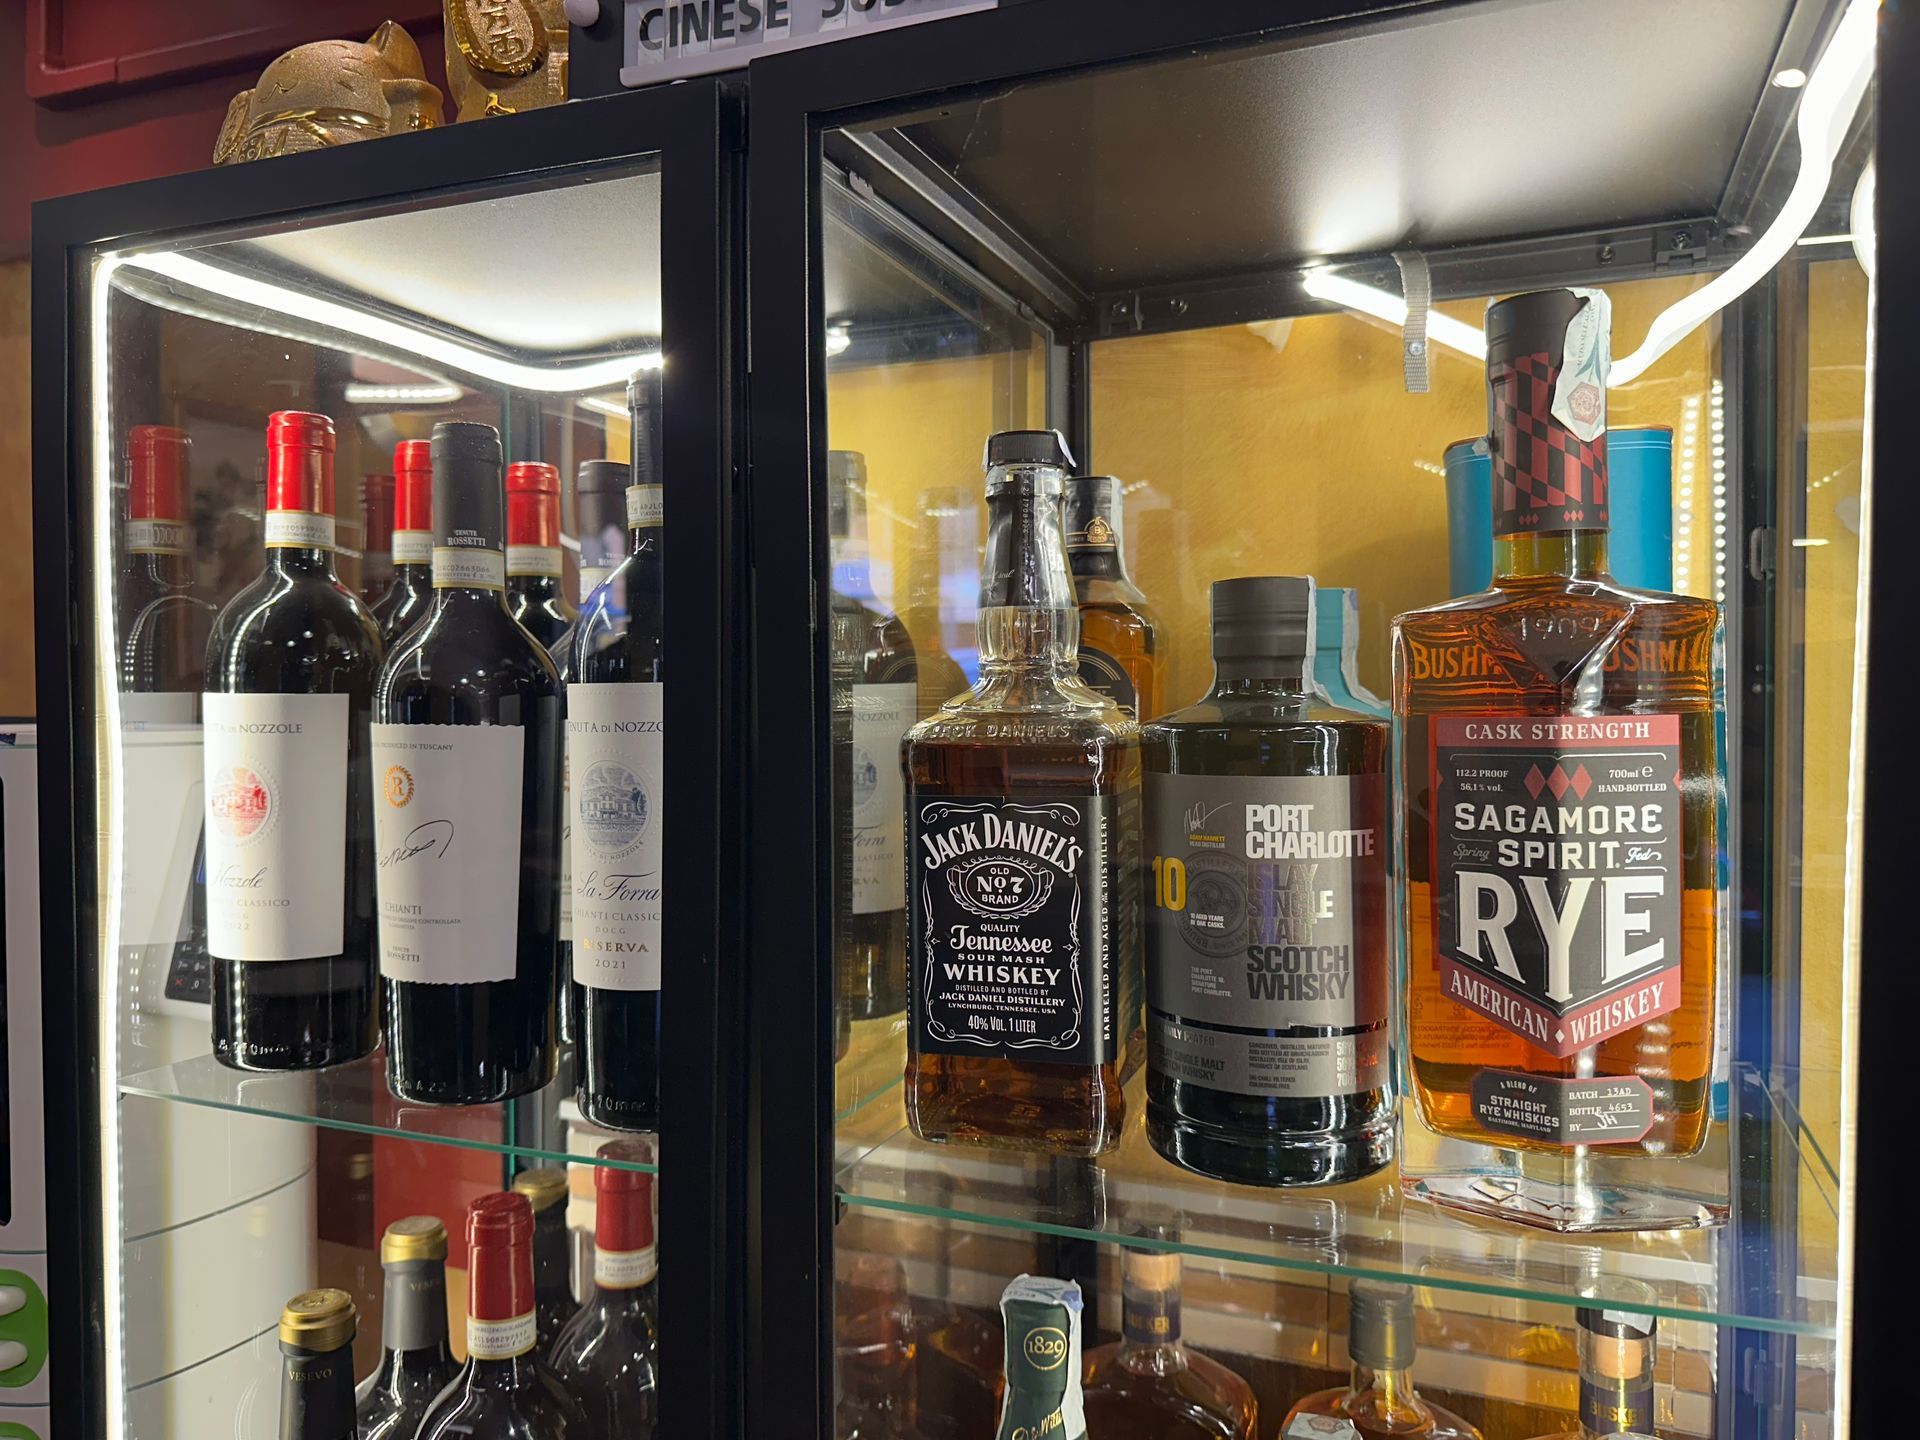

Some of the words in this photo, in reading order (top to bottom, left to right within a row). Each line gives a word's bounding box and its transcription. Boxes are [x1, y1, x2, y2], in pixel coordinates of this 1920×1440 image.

[639, 0, 788, 51] CINESE
[454, 529, 478, 537] TENUTE
[448, 537, 486, 547] ROSSETTI
[239, 723, 303, 734] NOZZOLE
[601, 725, 611, 733] DI
[1465, 723, 1524, 740] CASK
[1532, 721, 1651, 741] STRENGTH
[419, 743, 454, 751] TUSCANY
[1455, 769, 1477, 778] 112.2
[1479, 769, 1509, 778] PROOF
[1608, 768, 1639, 780] 700ml
[391, 776, 404, 796] R
[1486, 784, 1504, 793] vol.
[1597, 783, 1667, 793] HAND-BOTTLED
[1245, 803, 1314, 832] PORT
[1454, 802, 1663, 835] SAGAMORE
[920, 819, 983, 871] JACK
[982, 812, 1084, 874] DANIEL'S
[1245, 829, 1375, 860] CHARLOTTE
[1453, 843, 1490, 861] Spring
[1497, 838, 1620, 870] SPIRIT
[1624, 846, 1662, 864] Fed
[990, 866, 1010, 876] OLD
[1246, 863, 1319, 892] ISLAY
[1151, 854, 1188, 912] 10
[236, 898, 291, 908] CLASSICO
[981, 894, 1019, 905] BRAND
[1246, 889, 1335, 919] SINGLE
[384, 901, 422, 915] CHIANTI
[1207, 914, 1224, 922] YEARS
[1207, 921, 1225, 929] CASKS.
[595, 927, 626, 935] DOCG
[980, 923, 1020, 933] QUALITY
[1246, 916, 1318, 945] MALT
[950, 924, 1053, 953] Tennessee
[1455, 870, 1665, 1003] RYE
[583, 938, 649, 953] RISERVA
[386, 950, 420, 963] ROSSETTI
[595, 959, 626, 969] 2021
[957, 953, 996, 962] SOUR
[1002, 955, 1045, 964] MASH
[1246, 944, 1349, 973] SCOTCH
[943, 963, 1062, 986] WHISKEY
[955, 984, 990, 993] DISTILLED
[991, 985, 1006, 994] AND
[1007, 986, 1039, 995] BOTTLED
[1040, 988, 1049, 996] BY
[1246, 972, 1350, 1001] WHISKY
[939, 992, 965, 1001] JACK
[968, 993, 1005, 1004] DANIEL
[1007, 996, 1066, 1007] DISTILLERY
[1450, 969, 1549, 1043] AMERICAN
[1569, 980, 1665, 1045] WHISKEY
[967, 1014, 989, 1030] 40%
[1008, 1016, 1014, 1032] 1
[1015, 1018, 1037, 1034] LITER
[1200, 1056, 1225, 1071] MALT
[1500, 1081, 1505, 1090] A
[1506, 1080, 1527, 1091] BLEND
[1529, 1084, 1538, 1094] OF
[1569, 1090, 1598, 1100] BATCH
[1607, 1087, 1632, 1096] 13AD
[1490, 1095, 1548, 1114] STRAIGHT
[1569, 1106, 1603, 1117] BOTTLE
[1608, 1102, 1634, 1112] 4653
[1479, 1104, 1501, 1117] RYE
[1503, 1109, 1560, 1128] WHISKIES
[1488, 1116, 1521, 1128] BALTIMORE,
[1521, 1122, 1551, 1134] MARYLAND
[1569, 1123, 1582, 1132] BY
[1028, 1335, 1065, 1359] 1829
[289, 1368, 333, 1381] VESEVO
